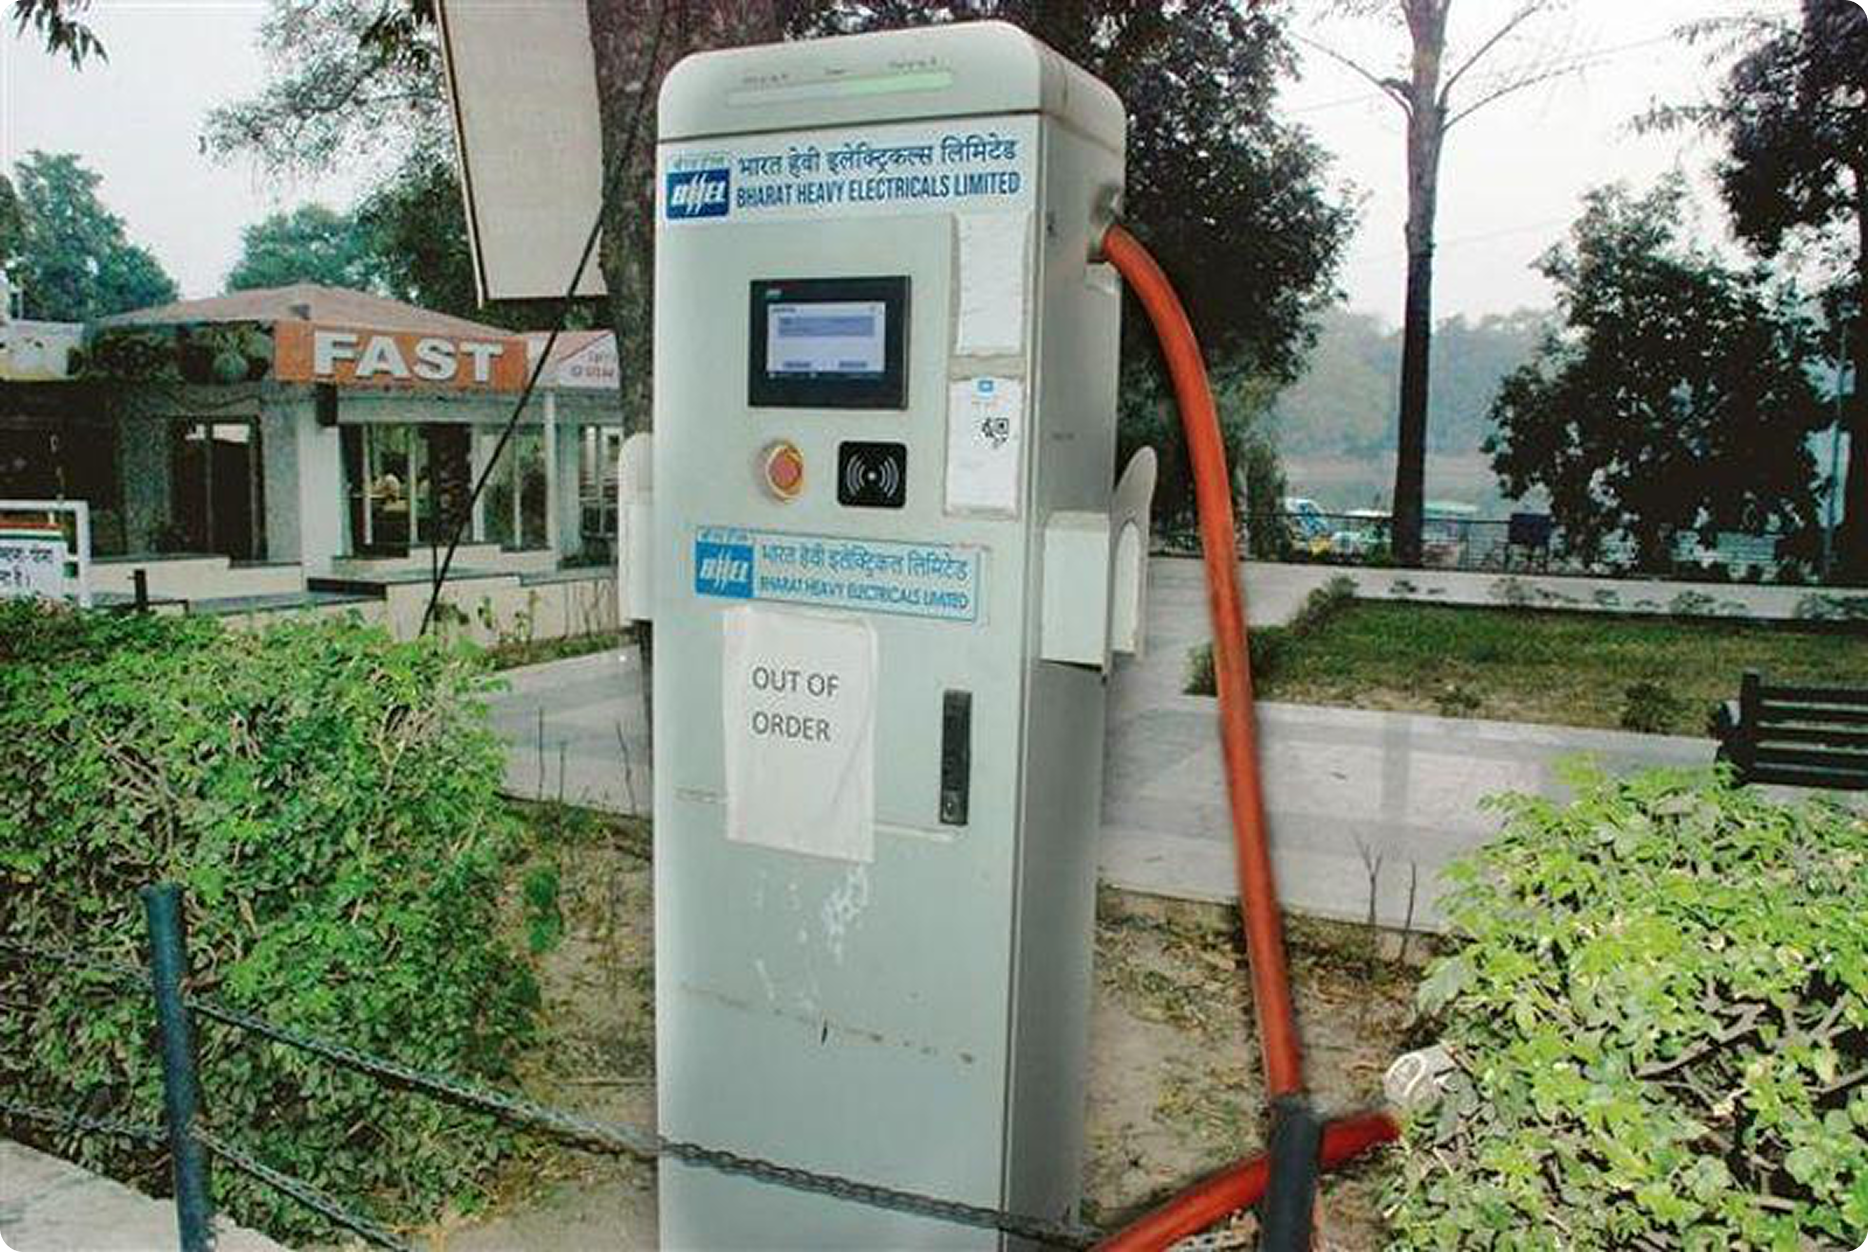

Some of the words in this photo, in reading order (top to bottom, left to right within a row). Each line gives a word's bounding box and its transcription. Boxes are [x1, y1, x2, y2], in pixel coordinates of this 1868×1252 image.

[738, 154, 782, 176] भारत
[941, 132, 1018, 163] लिमिटेड
[736, 183, 793, 208] BHARAT
[797, 179, 845, 203] HEAVY
[848, 173, 950, 201] ELECTRICALS
[953, 171, 1021, 197] LIMITED
[314, 329, 504, 382] FAST
[753, 666, 802, 693] OUT
[807, 673, 839, 697] OF
[753, 711, 831, 742] ORDER
